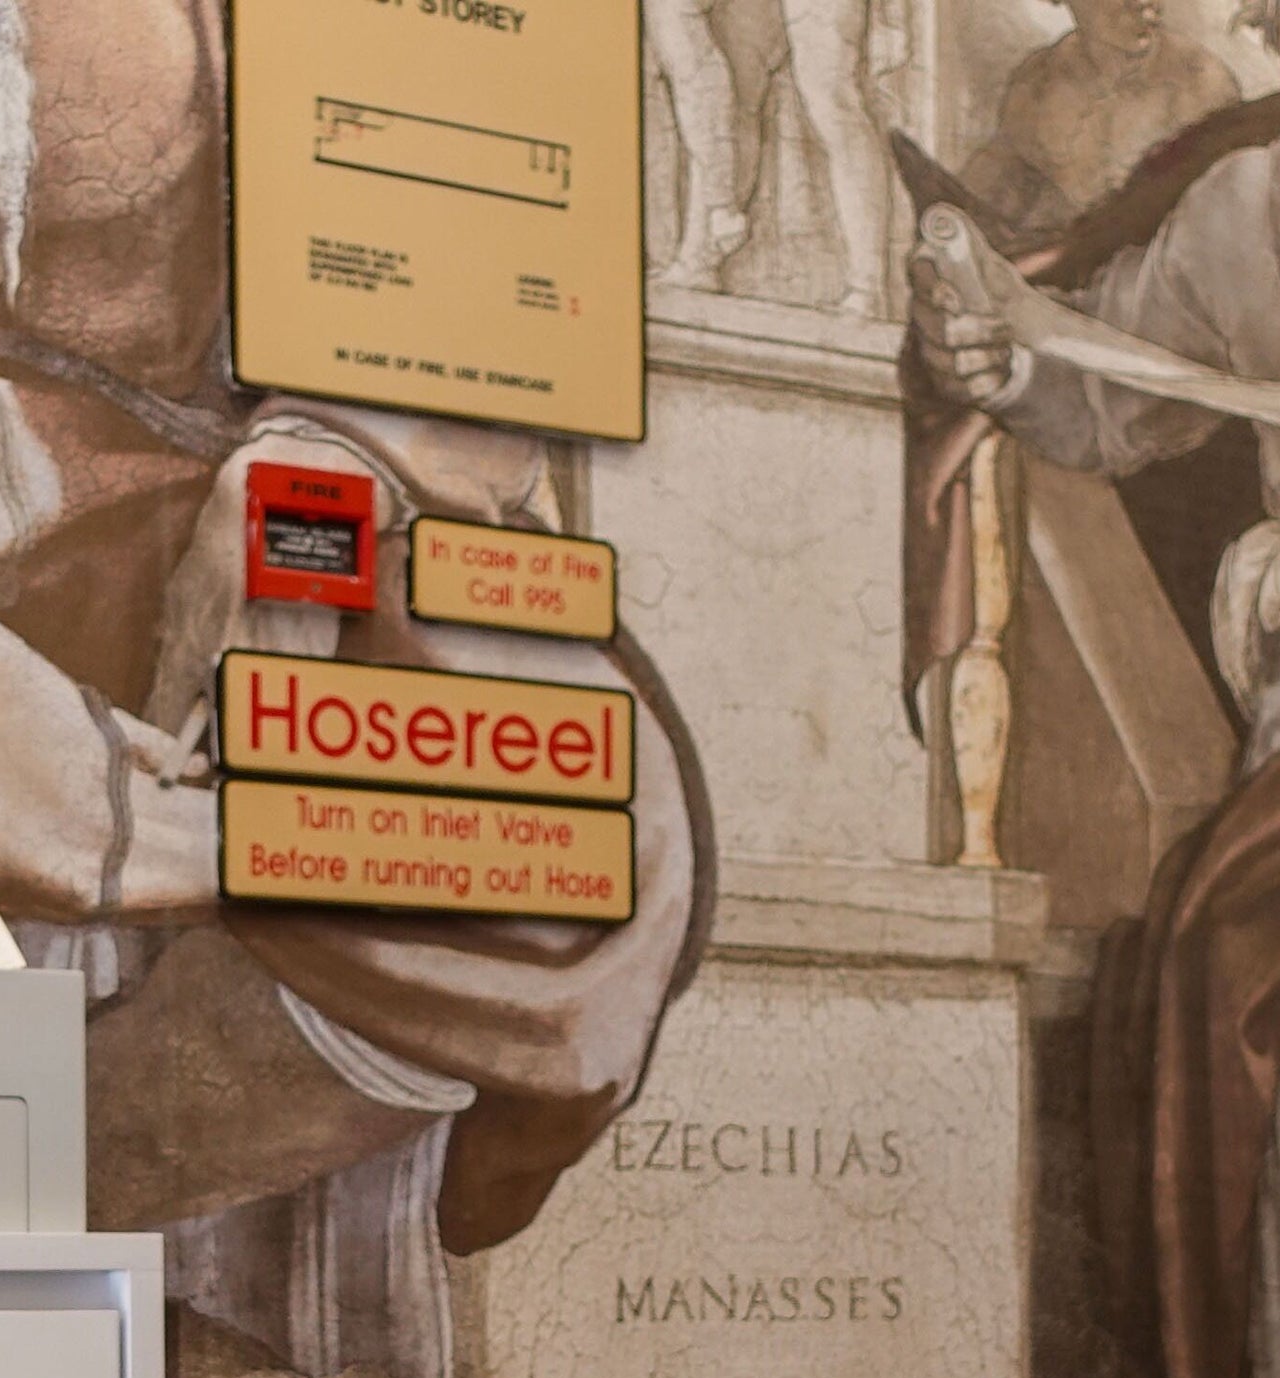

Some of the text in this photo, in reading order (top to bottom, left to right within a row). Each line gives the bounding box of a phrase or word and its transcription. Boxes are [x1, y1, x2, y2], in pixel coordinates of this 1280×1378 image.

[419, 0, 527, 33] STOREY
[354, 351, 390, 369] CASE
[455, 365, 481, 382] USE
[291, 481, 342, 499] FIRE
[429, 536, 451, 561] In
[460, 545, 518, 571] case
[530, 553, 553, 574] of
[467, 577, 567, 615] Call 995
[249, 670, 614, 781] Hosereel
[296, 795, 575, 850] Turn on Inlet Valve
[249, 843, 615, 901] Before running out Hose
[613, 1120, 904, 1178] EZECHIAS
[615, 1273, 905, 1325] MANASSES
